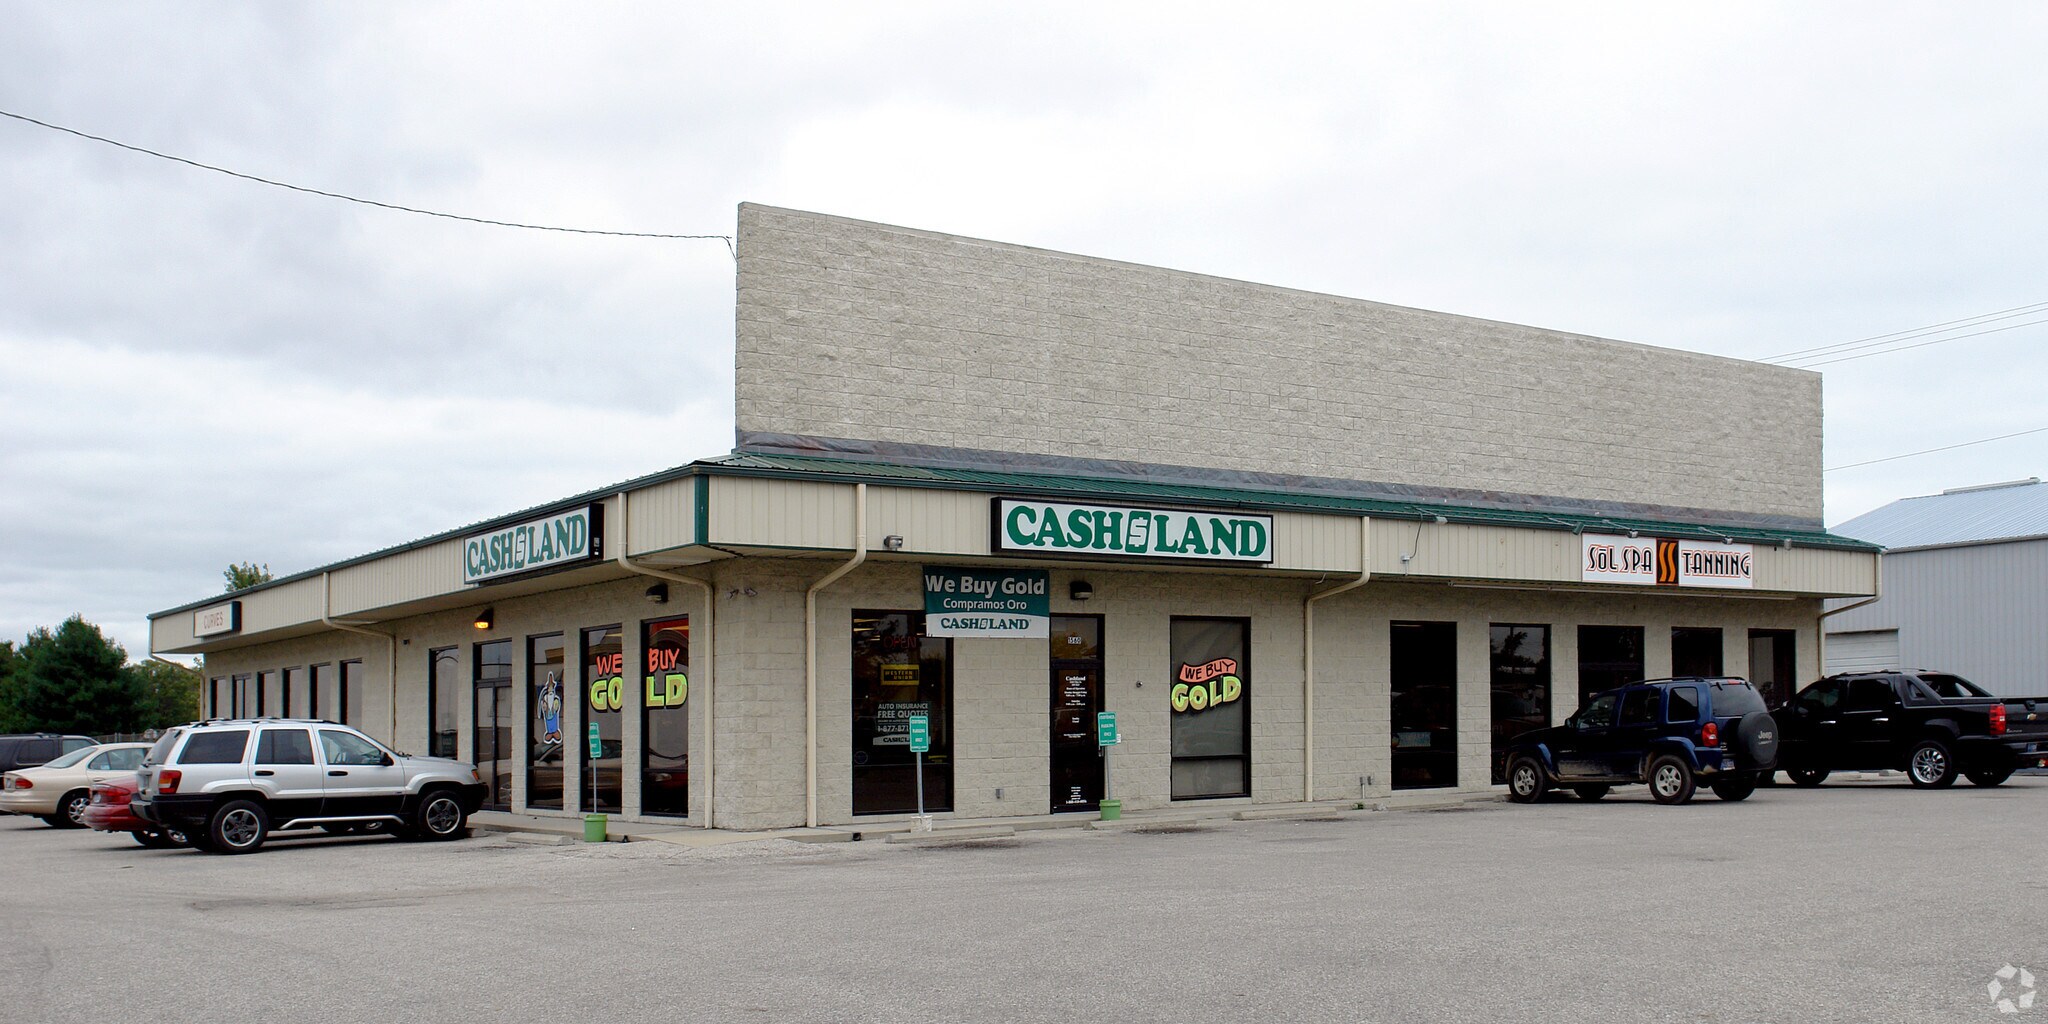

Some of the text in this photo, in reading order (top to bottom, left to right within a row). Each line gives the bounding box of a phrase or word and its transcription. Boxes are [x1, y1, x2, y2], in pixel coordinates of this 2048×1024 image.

[1620, 546, 1653, 574] SPA
[1682, 550, 1751, 578] TANNING
[925, 575, 1045, 599] We Buy Gold
[943, 598, 1027, 611] Compramos Oro
[883, 636, 917, 649] OPEN
[596, 648, 680, 676] WE BUY
[1185, 660, 1235, 680] WE BUY
[1171, 676, 1242, 712] GOLD
[878, 710, 929, 719] FREE QUOTES
